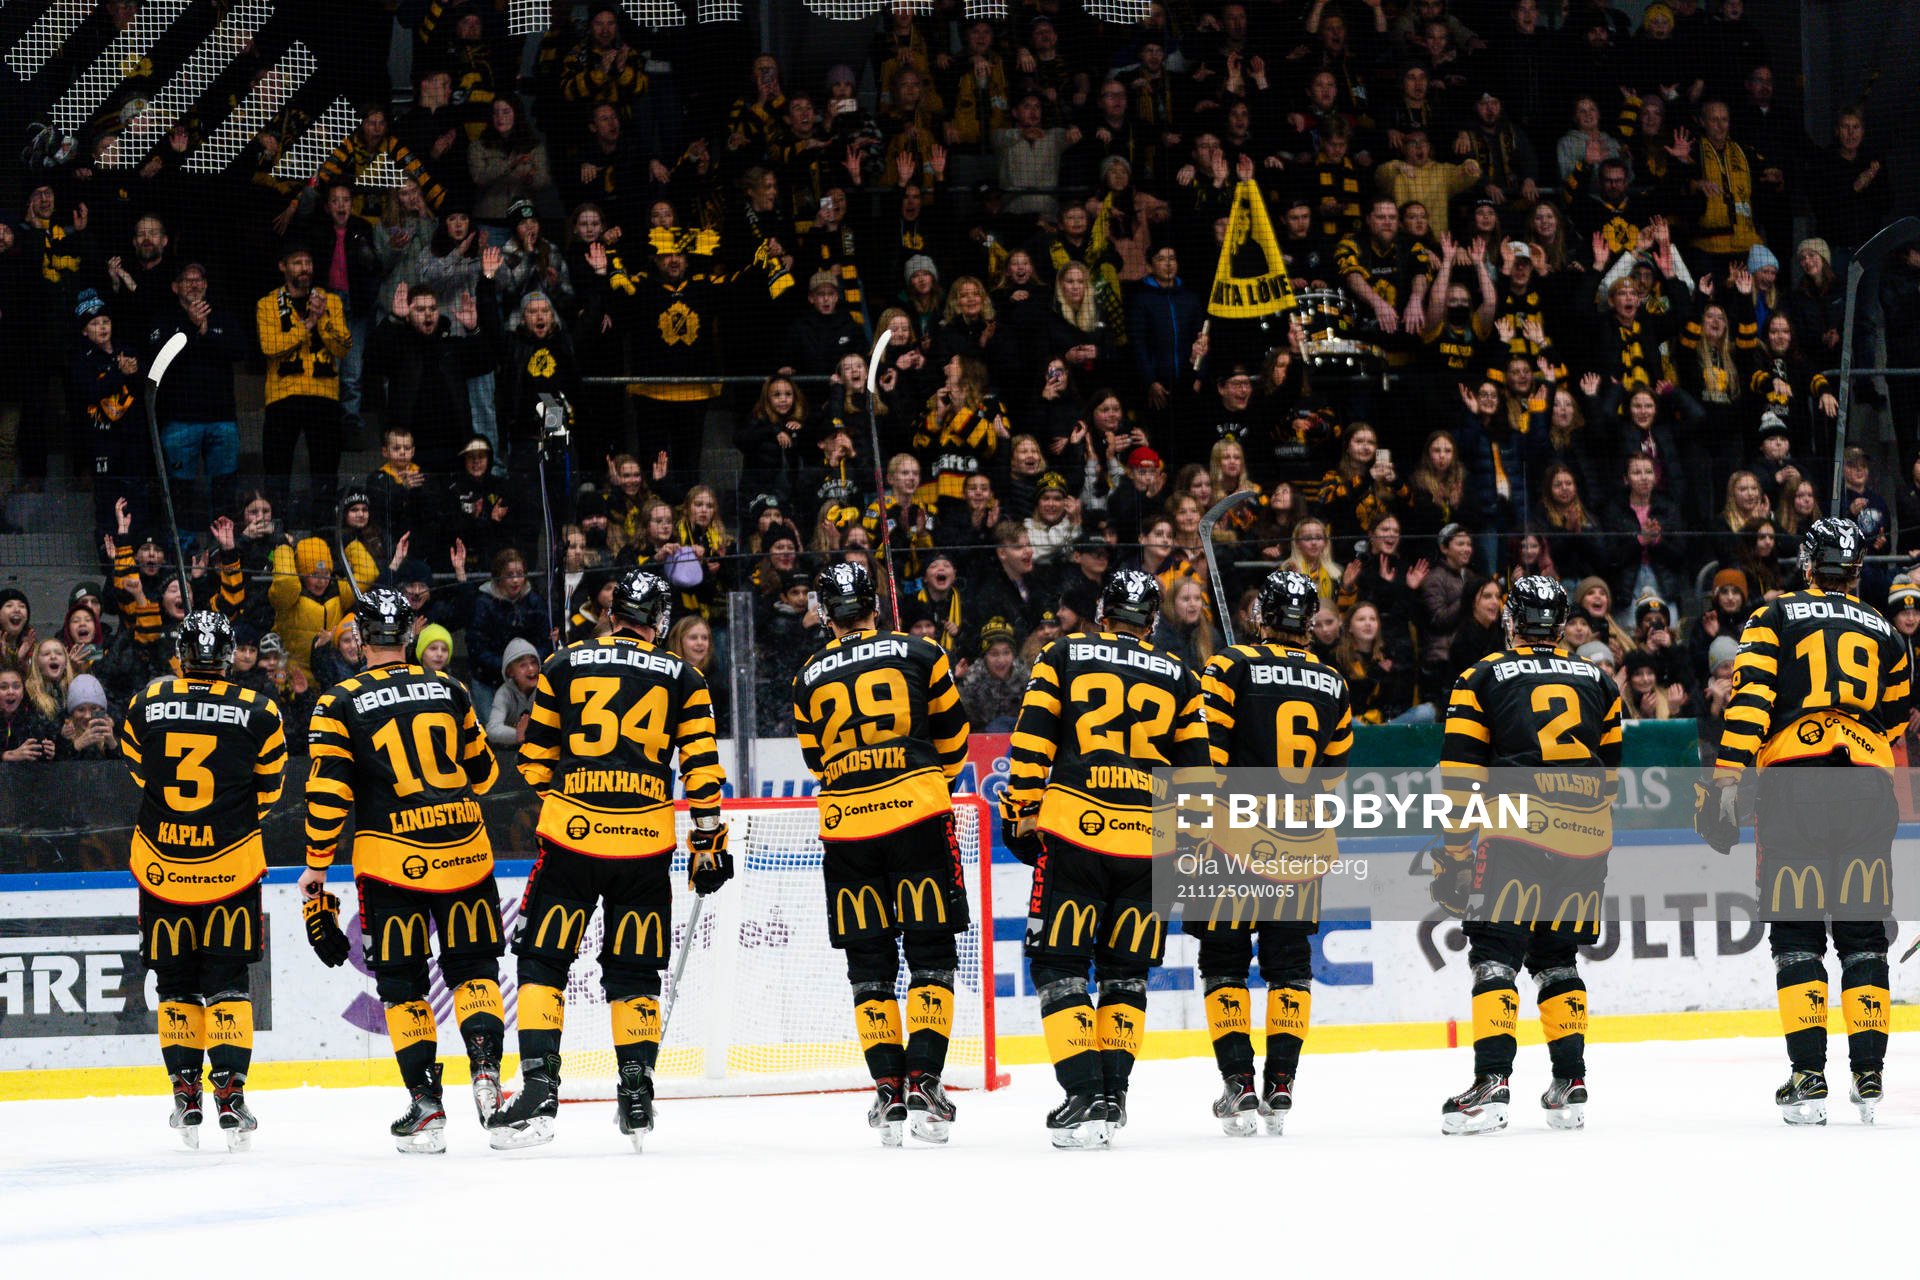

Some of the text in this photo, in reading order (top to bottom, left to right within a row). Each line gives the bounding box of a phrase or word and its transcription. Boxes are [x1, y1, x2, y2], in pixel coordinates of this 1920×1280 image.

[1793, 602, 1891, 637] BOLIDEN
[575, 649, 683, 680] BOLIDEN
[807, 640, 908, 682] BOLIDEN
[1076, 644, 1182, 681] BOLIDEN
[1500, 659, 1600, 682] BOLIDEN
[1796, 629, 1880, 711] 19
[1255, 665, 1342, 699] BOLIDEN
[150, 701, 250, 727] BOLIDEN
[569, 677, 670, 763] 34
[809, 667, 912, 766] 29
[1070, 672, 1176, 765] 22
[1530, 684, 1591, 760] 2
[371, 712, 468, 797] 10
[1276, 700, 1320, 784] 6
[164, 732, 217, 812] 3
[564, 767, 667, 803] KÜHNHACKL
[1534, 773, 1600, 799] WILSBY
[389, 797, 484, 834] LINDSTRÖM
[844, 799, 914, 817] Contractor
[157, 821, 215, 847] KAPLA
[594, 823, 660, 838] Contractor
[432, 852, 488, 870] Contractor
[167, 873, 237, 884] Contractor
[1030, 843, 1048, 913] REPA
[162, 1031, 196, 1040] NORRAN
[207, 1031, 244, 1040] NORRAN
[861, 1029, 897, 1040] NORRAN
[910, 1016, 948, 1025] NORRAN
[1271, 1017, 1305, 1029] NORRAN
[1854, 1019, 1887, 1028] NORRAN
